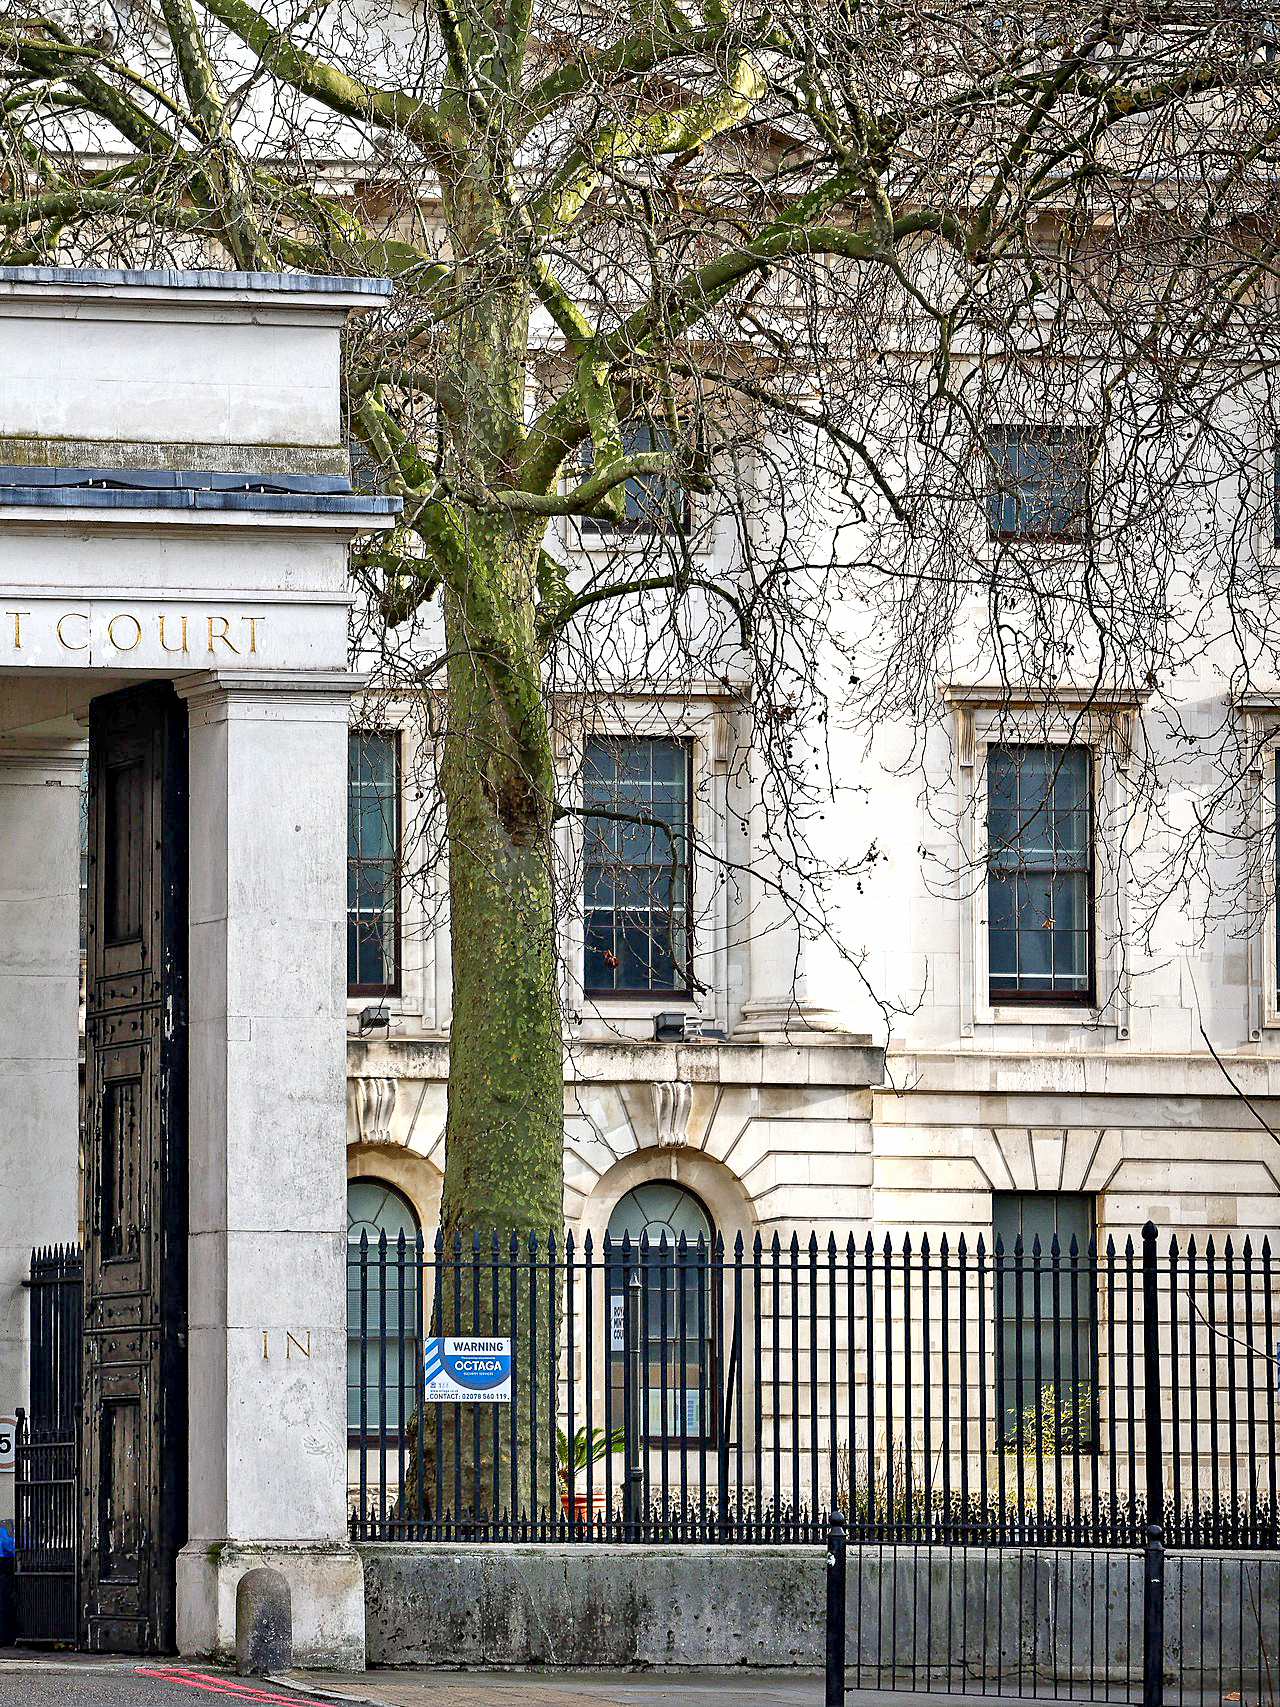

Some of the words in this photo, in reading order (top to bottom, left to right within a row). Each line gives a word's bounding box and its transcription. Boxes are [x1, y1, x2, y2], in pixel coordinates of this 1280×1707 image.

[56, 613, 266, 655] COURT
[262, 1330, 311, 1360] IN
[453, 1342, 504, 1352] WARNING
[455, 1361, 502, 1371] OCTAGA
